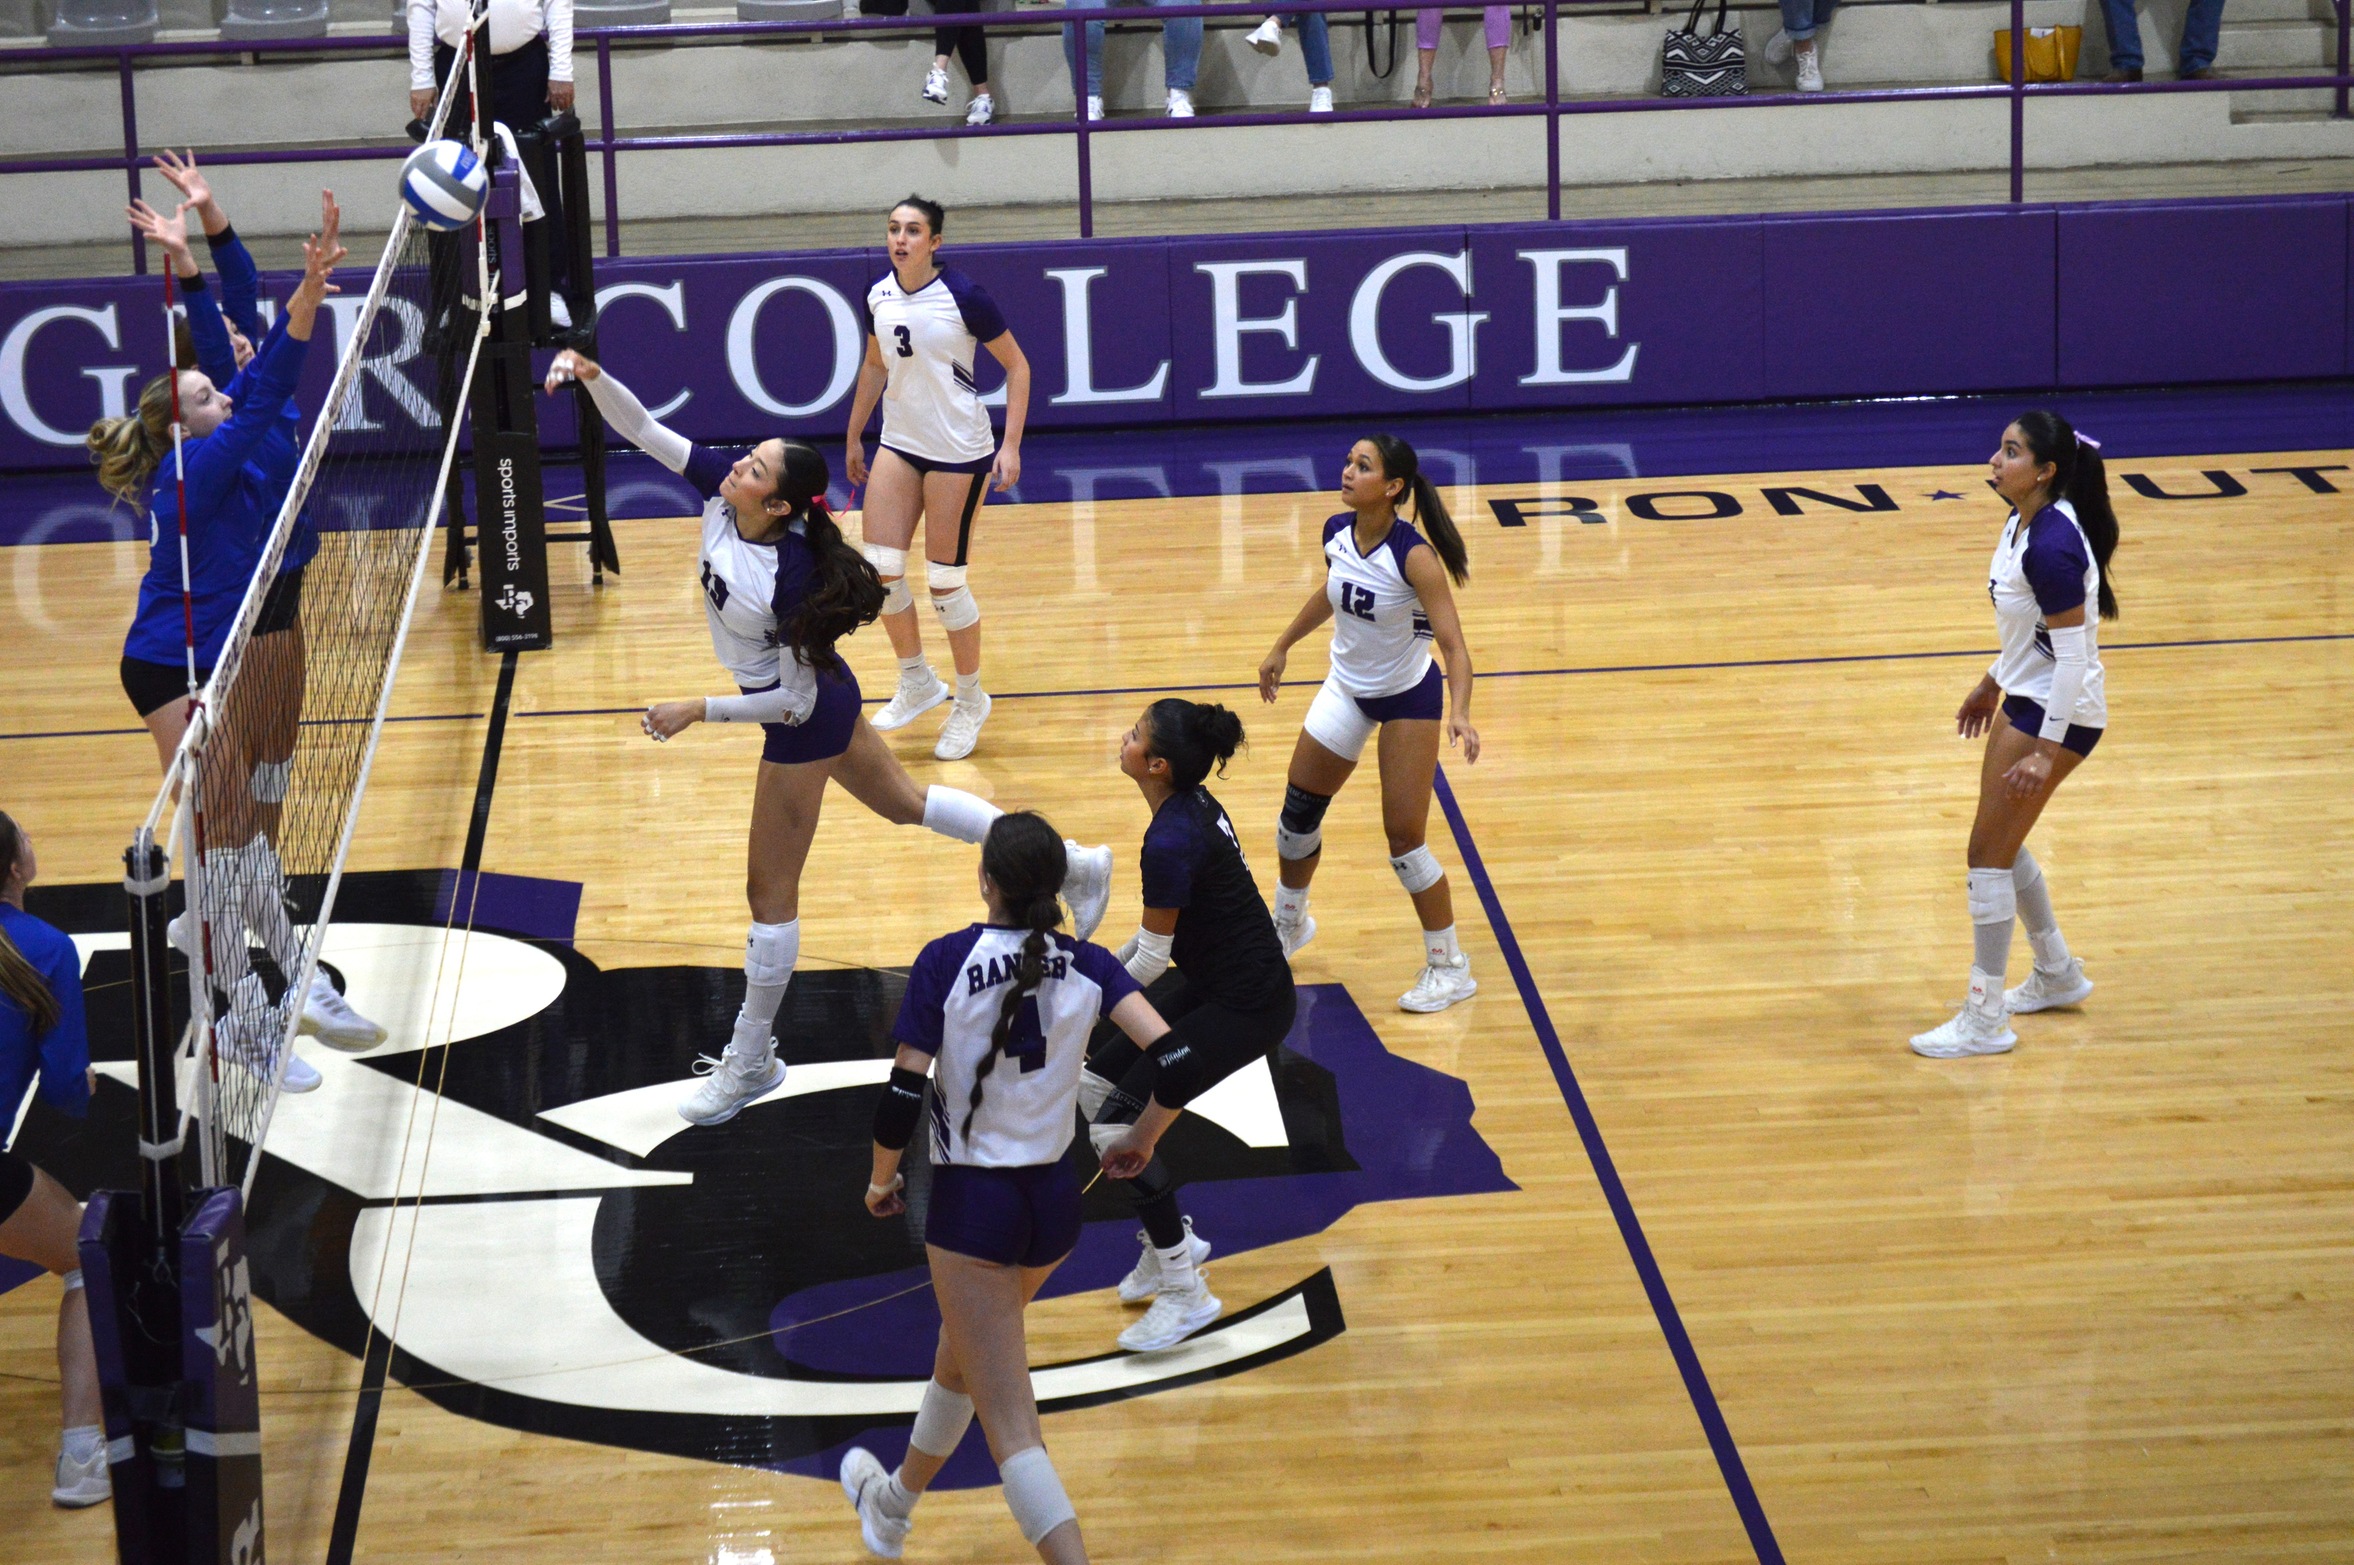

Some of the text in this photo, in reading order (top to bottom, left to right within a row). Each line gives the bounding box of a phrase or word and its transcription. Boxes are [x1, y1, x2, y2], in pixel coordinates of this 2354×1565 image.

[894, 325, 914, 358] 3
[497, 458, 522, 572] sports imports
[1488, 465, 2350, 527] RON UT
[1341, 581, 1376, 623] 12
[967, 953, 1067, 997] RANER
[1003, 994, 1048, 1075] 4
